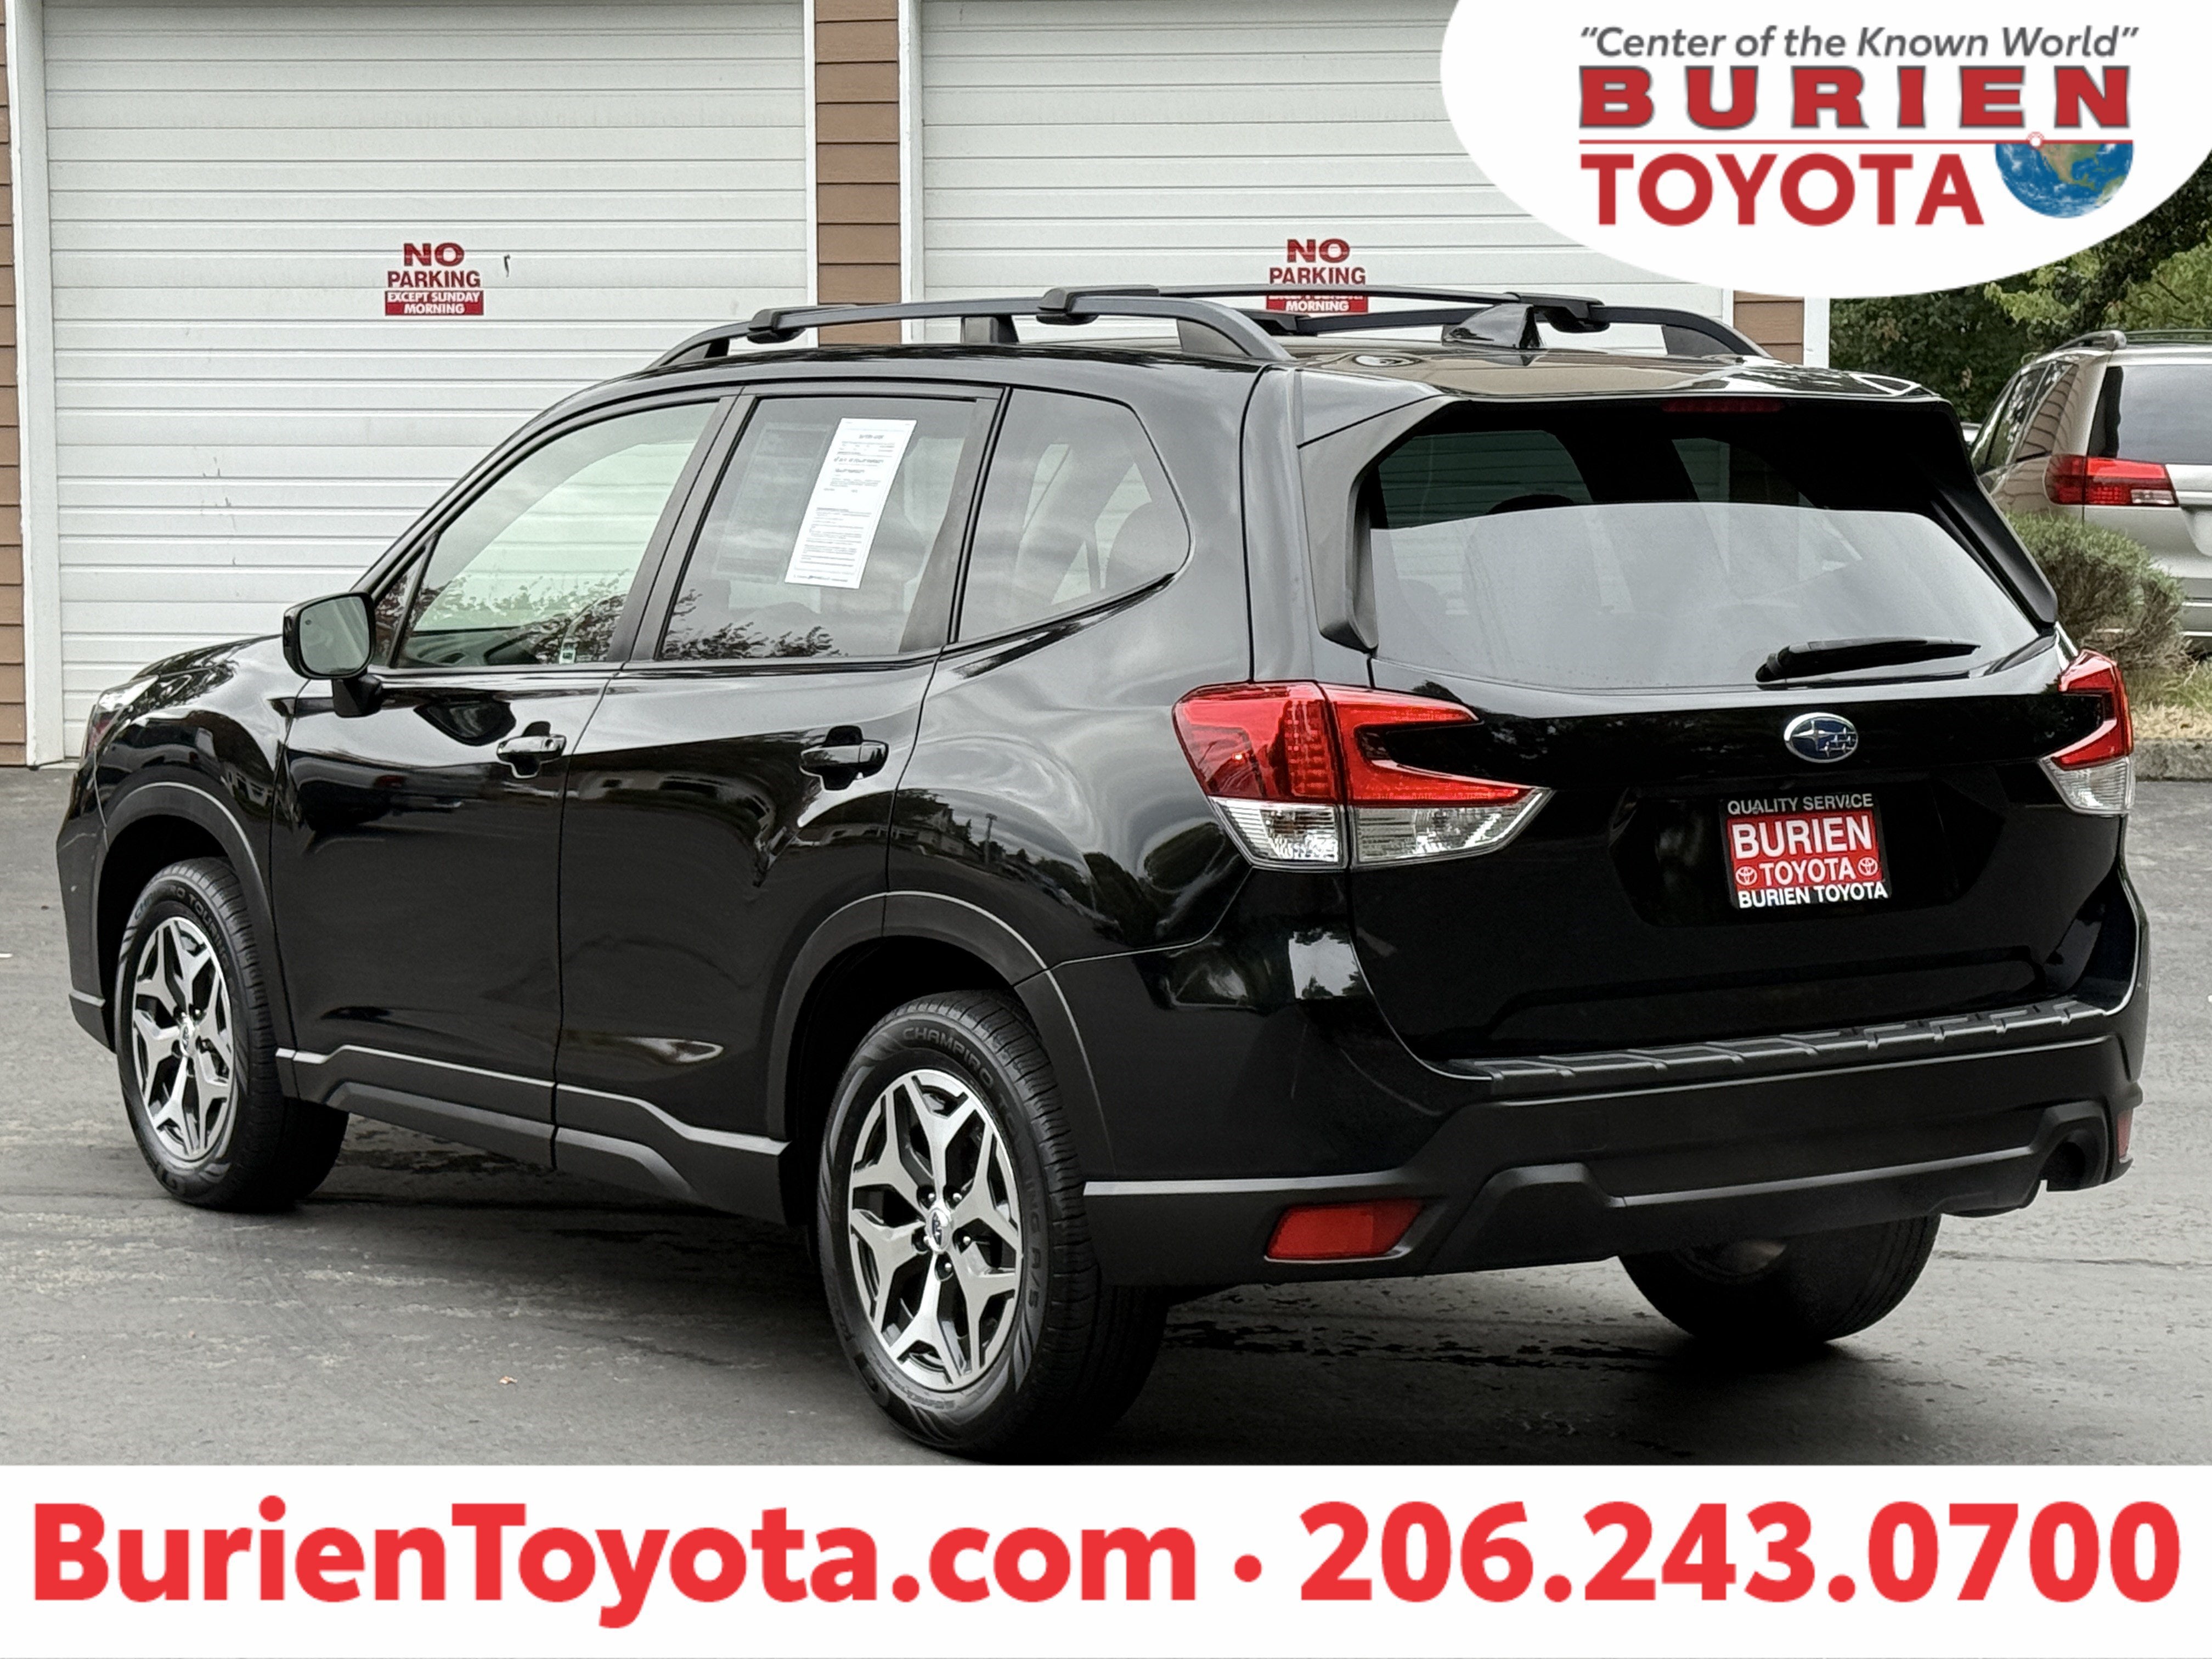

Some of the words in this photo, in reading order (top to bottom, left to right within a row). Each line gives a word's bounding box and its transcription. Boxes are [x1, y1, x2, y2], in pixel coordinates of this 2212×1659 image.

[403, 242, 465, 267] NO
[1287, 238, 1350, 263] NO
[387, 270, 481, 288] PARKING
[1269, 267, 1366, 285] PARKING
[387, 292, 429, 303] EXCEPT
[431, 292, 480, 302] SUNDAY
[403, 303, 465, 314] MORNING
[1285, 301, 1350, 312] MORNING
[1728, 797, 1799, 815] QUALITY
[1803, 793, 1874, 811] SERVICE
[1732, 815, 1872, 859] BURIEN
[1759, 856, 1857, 887] TOYOTA
[1738, 885, 1810, 909] BURIEN
[1813, 881, 1889, 903] TOYOTA
[903, 1027, 994, 1088] CHAMPIRO
